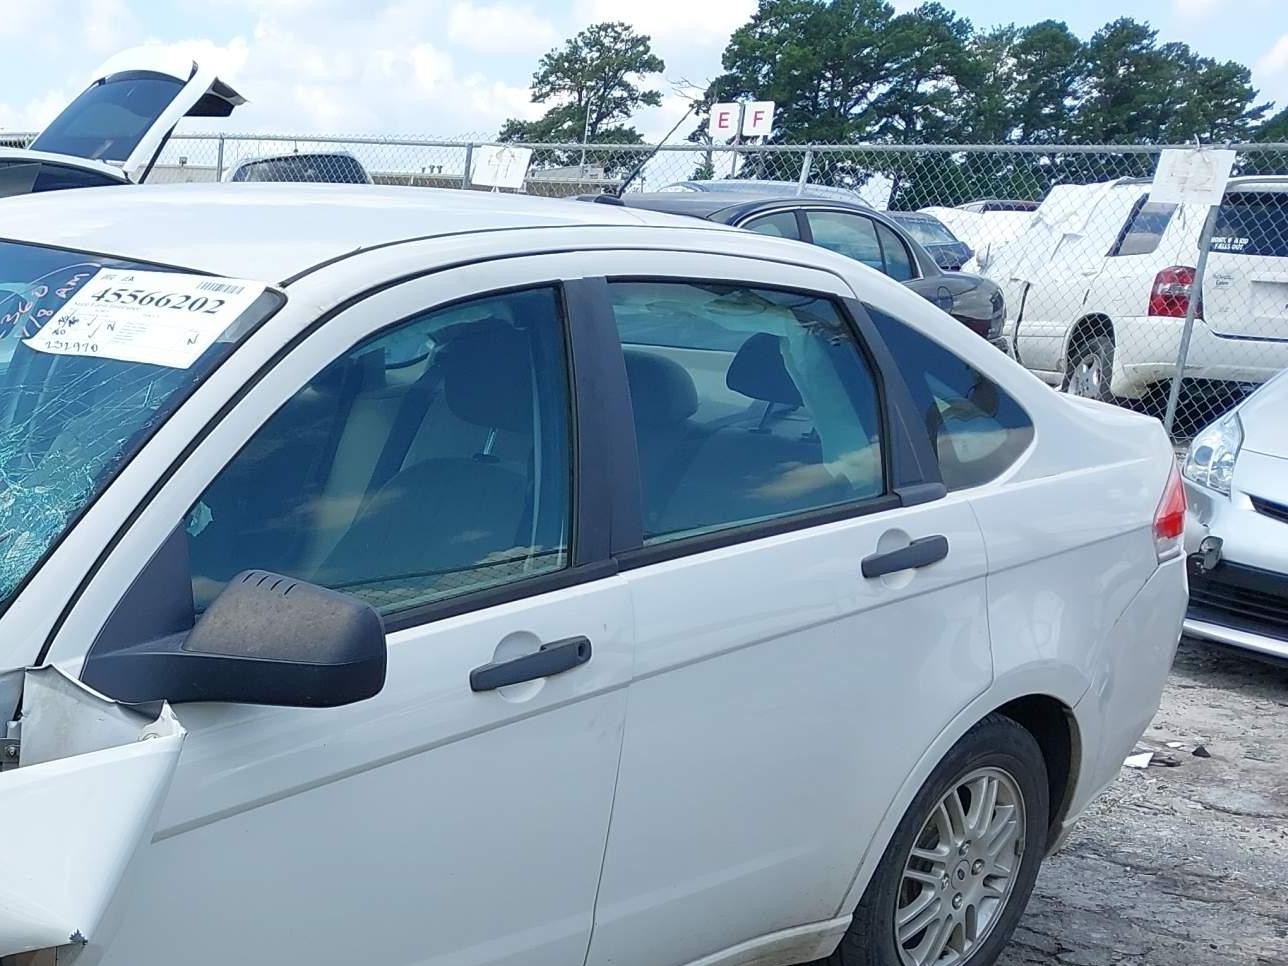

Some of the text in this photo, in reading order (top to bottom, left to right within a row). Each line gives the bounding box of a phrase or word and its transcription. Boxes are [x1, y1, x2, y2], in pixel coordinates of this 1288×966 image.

[718, 111, 731, 128] E
[752, 110, 766, 128] F
[90, 287, 226, 315] 45566202
